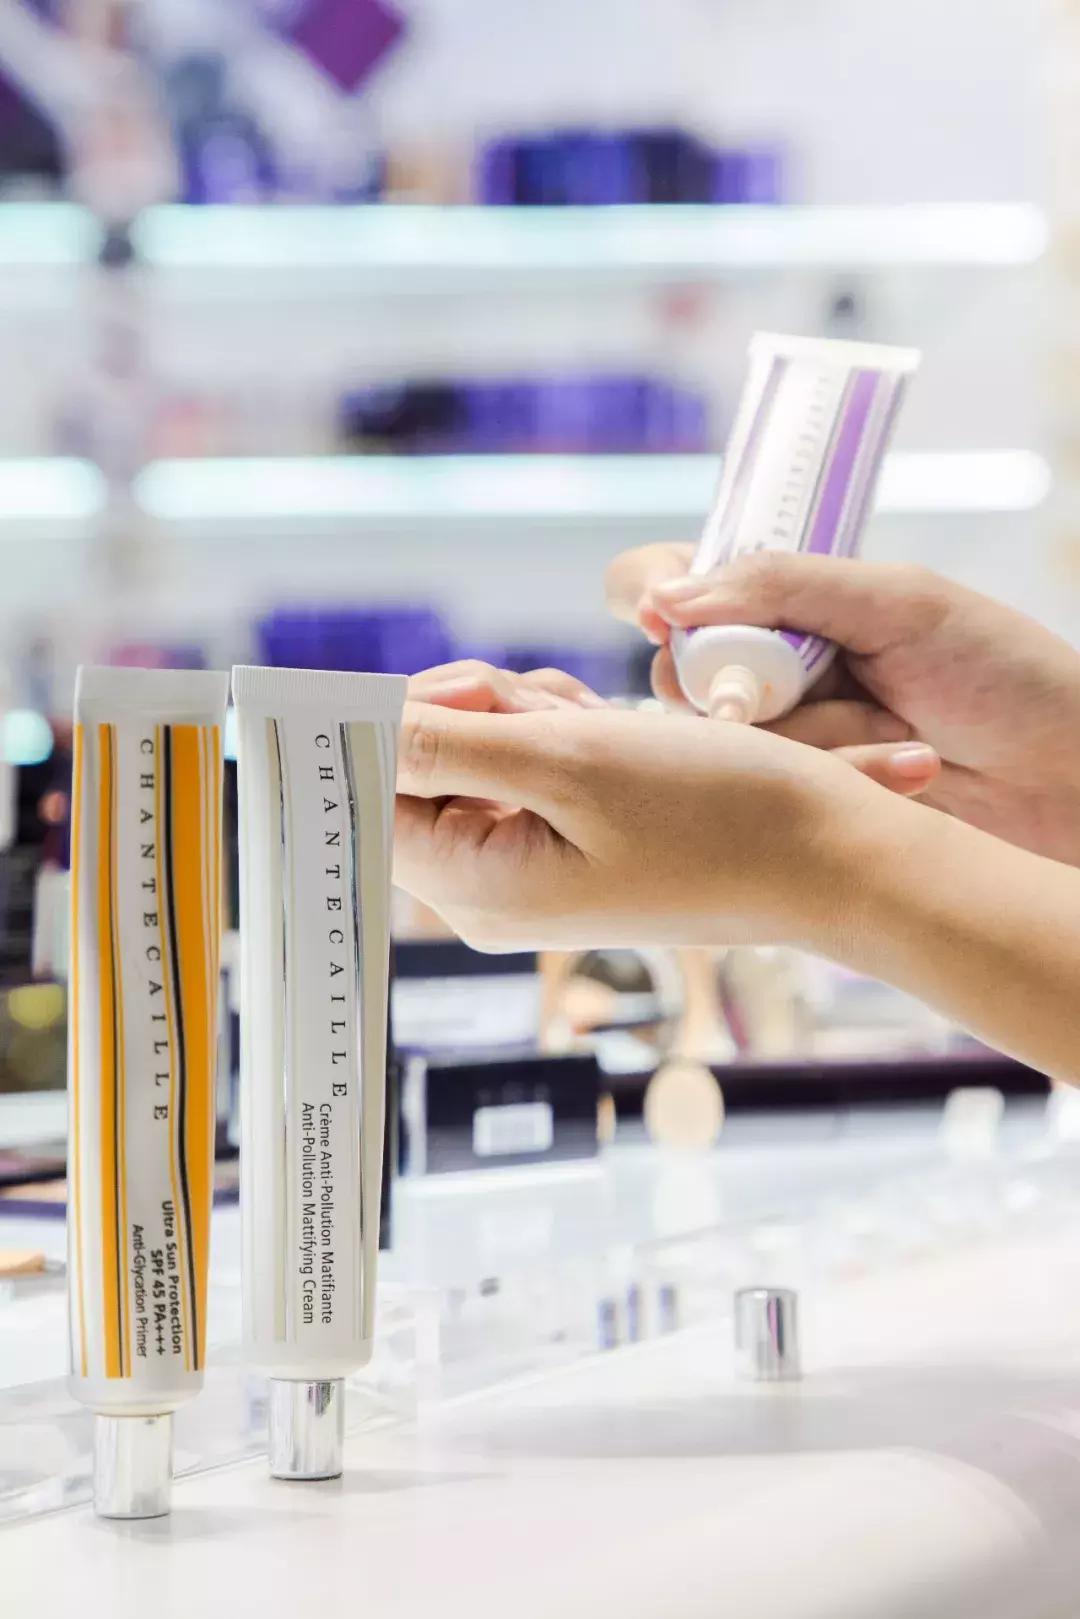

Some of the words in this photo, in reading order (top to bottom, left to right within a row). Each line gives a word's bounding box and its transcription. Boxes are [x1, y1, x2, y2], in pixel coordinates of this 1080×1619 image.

[139, 737, 169, 1121] CHANTECAILLE
[314, 734, 348, 1097] CHANTECAILLE
[301, 1102, 316, 1197] Anti-Pollution
[319, 1103, 332, 1147] Crème
[161, 1200, 176, 1237] Ultra
[320, 1150, 334, 1246] Anti-Pollution
[131, 1224, 148, 1313] Anti-Glycation
[150, 1248, 165, 1276] SPF
[166, 1241, 179, 1270] Sun
[299, 1203, 317, 1275] Mattifying
[152, 1280, 166, 1298] 45
[168, 1275, 183, 1354] Protection
[302, 1279, 316, 1324] Cream
[321, 1251, 335, 1324] Matifiante
[135, 1316, 149, 1358] Primer
[153, 1303, 166, 1355] PA+++
